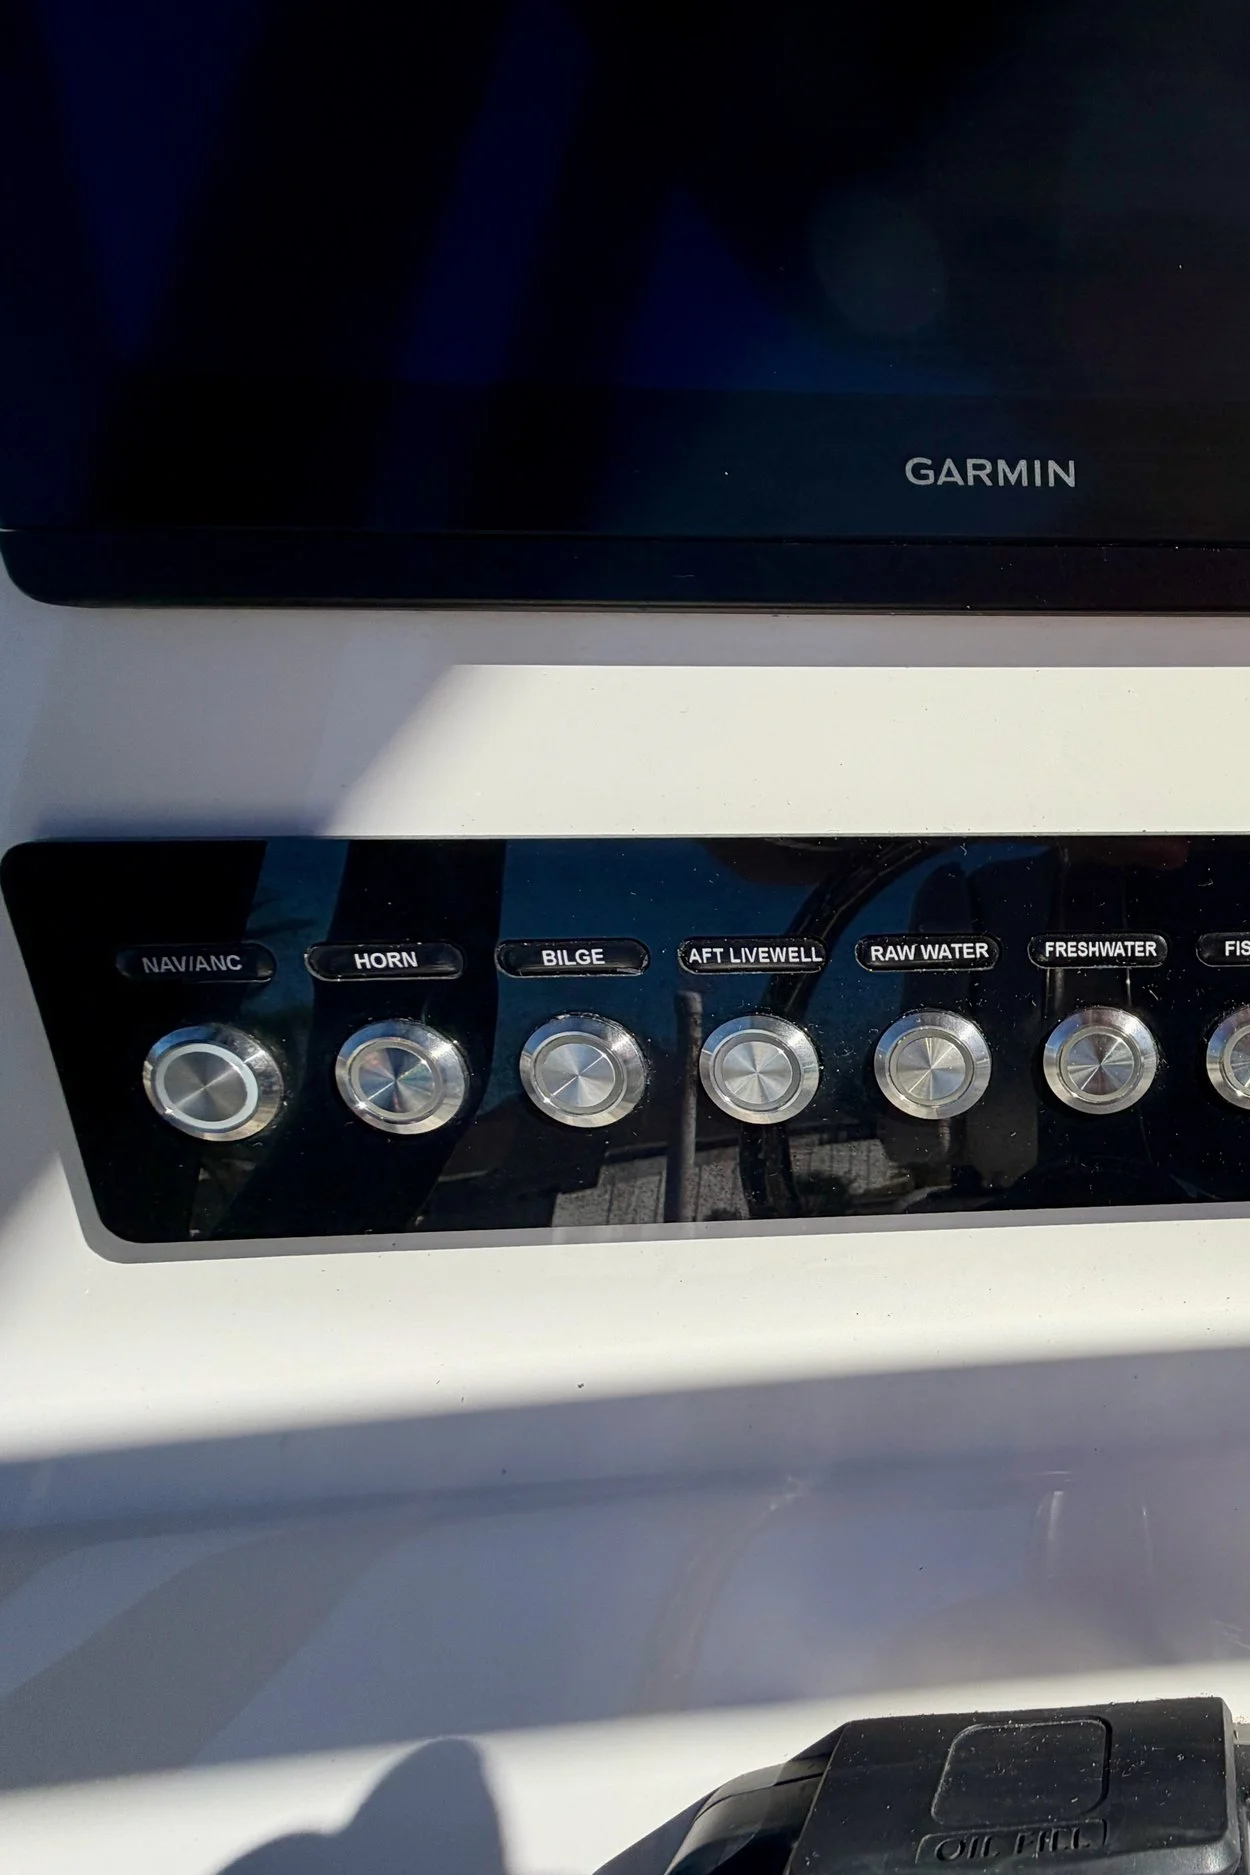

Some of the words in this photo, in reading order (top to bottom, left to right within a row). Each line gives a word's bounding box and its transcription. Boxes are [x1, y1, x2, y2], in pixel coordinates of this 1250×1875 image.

[904, 456, 1076, 488] GARMIN
[541, 948, 606, 966] BILGE
[688, 948, 723, 964] AFT
[730, 946, 823, 963] LIVEWELL
[870, 944, 916, 962] RAW
[920, 942, 989, 960] WATER
[1045, 940, 1157, 958] FRESHWATER
[354, 951, 419, 969] HORN
[934, 1835, 1001, 1862] OIL
[1014, 1827, 1091, 1855] FILL
